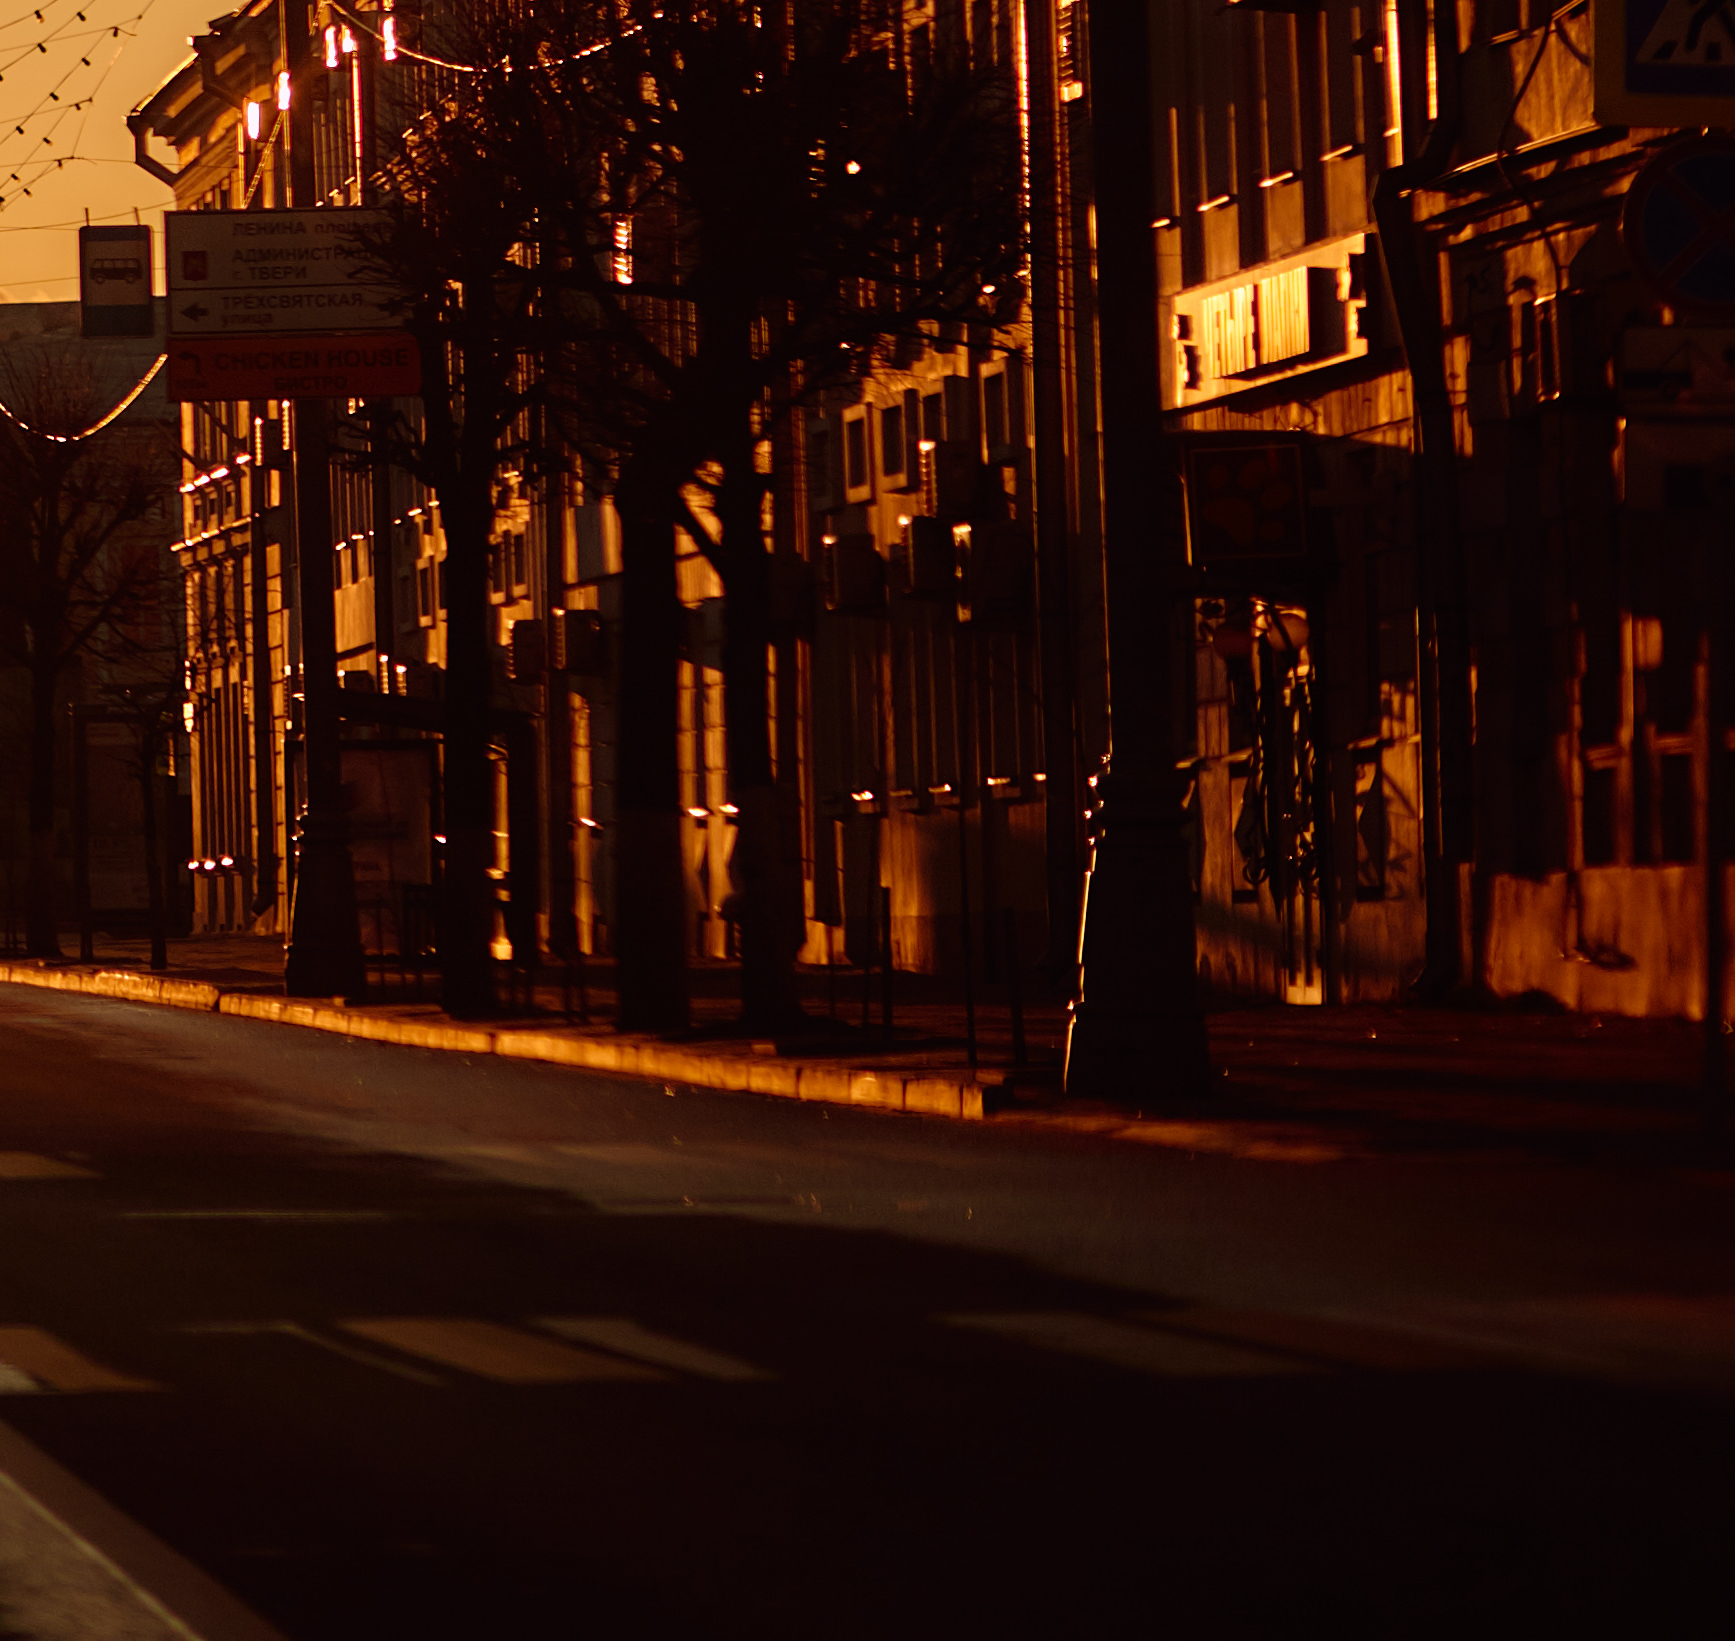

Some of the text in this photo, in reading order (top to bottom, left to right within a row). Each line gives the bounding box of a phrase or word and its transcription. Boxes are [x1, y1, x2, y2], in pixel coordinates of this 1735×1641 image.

[232, 222, 306, 237] ЛЕНИНА
[248, 266, 307, 280] ТВЕРИ
[221, 313, 273, 328] улица
[214, 348, 409, 371] CHICKEN HOUSE
[274, 376, 348, 391] БИСТРО
